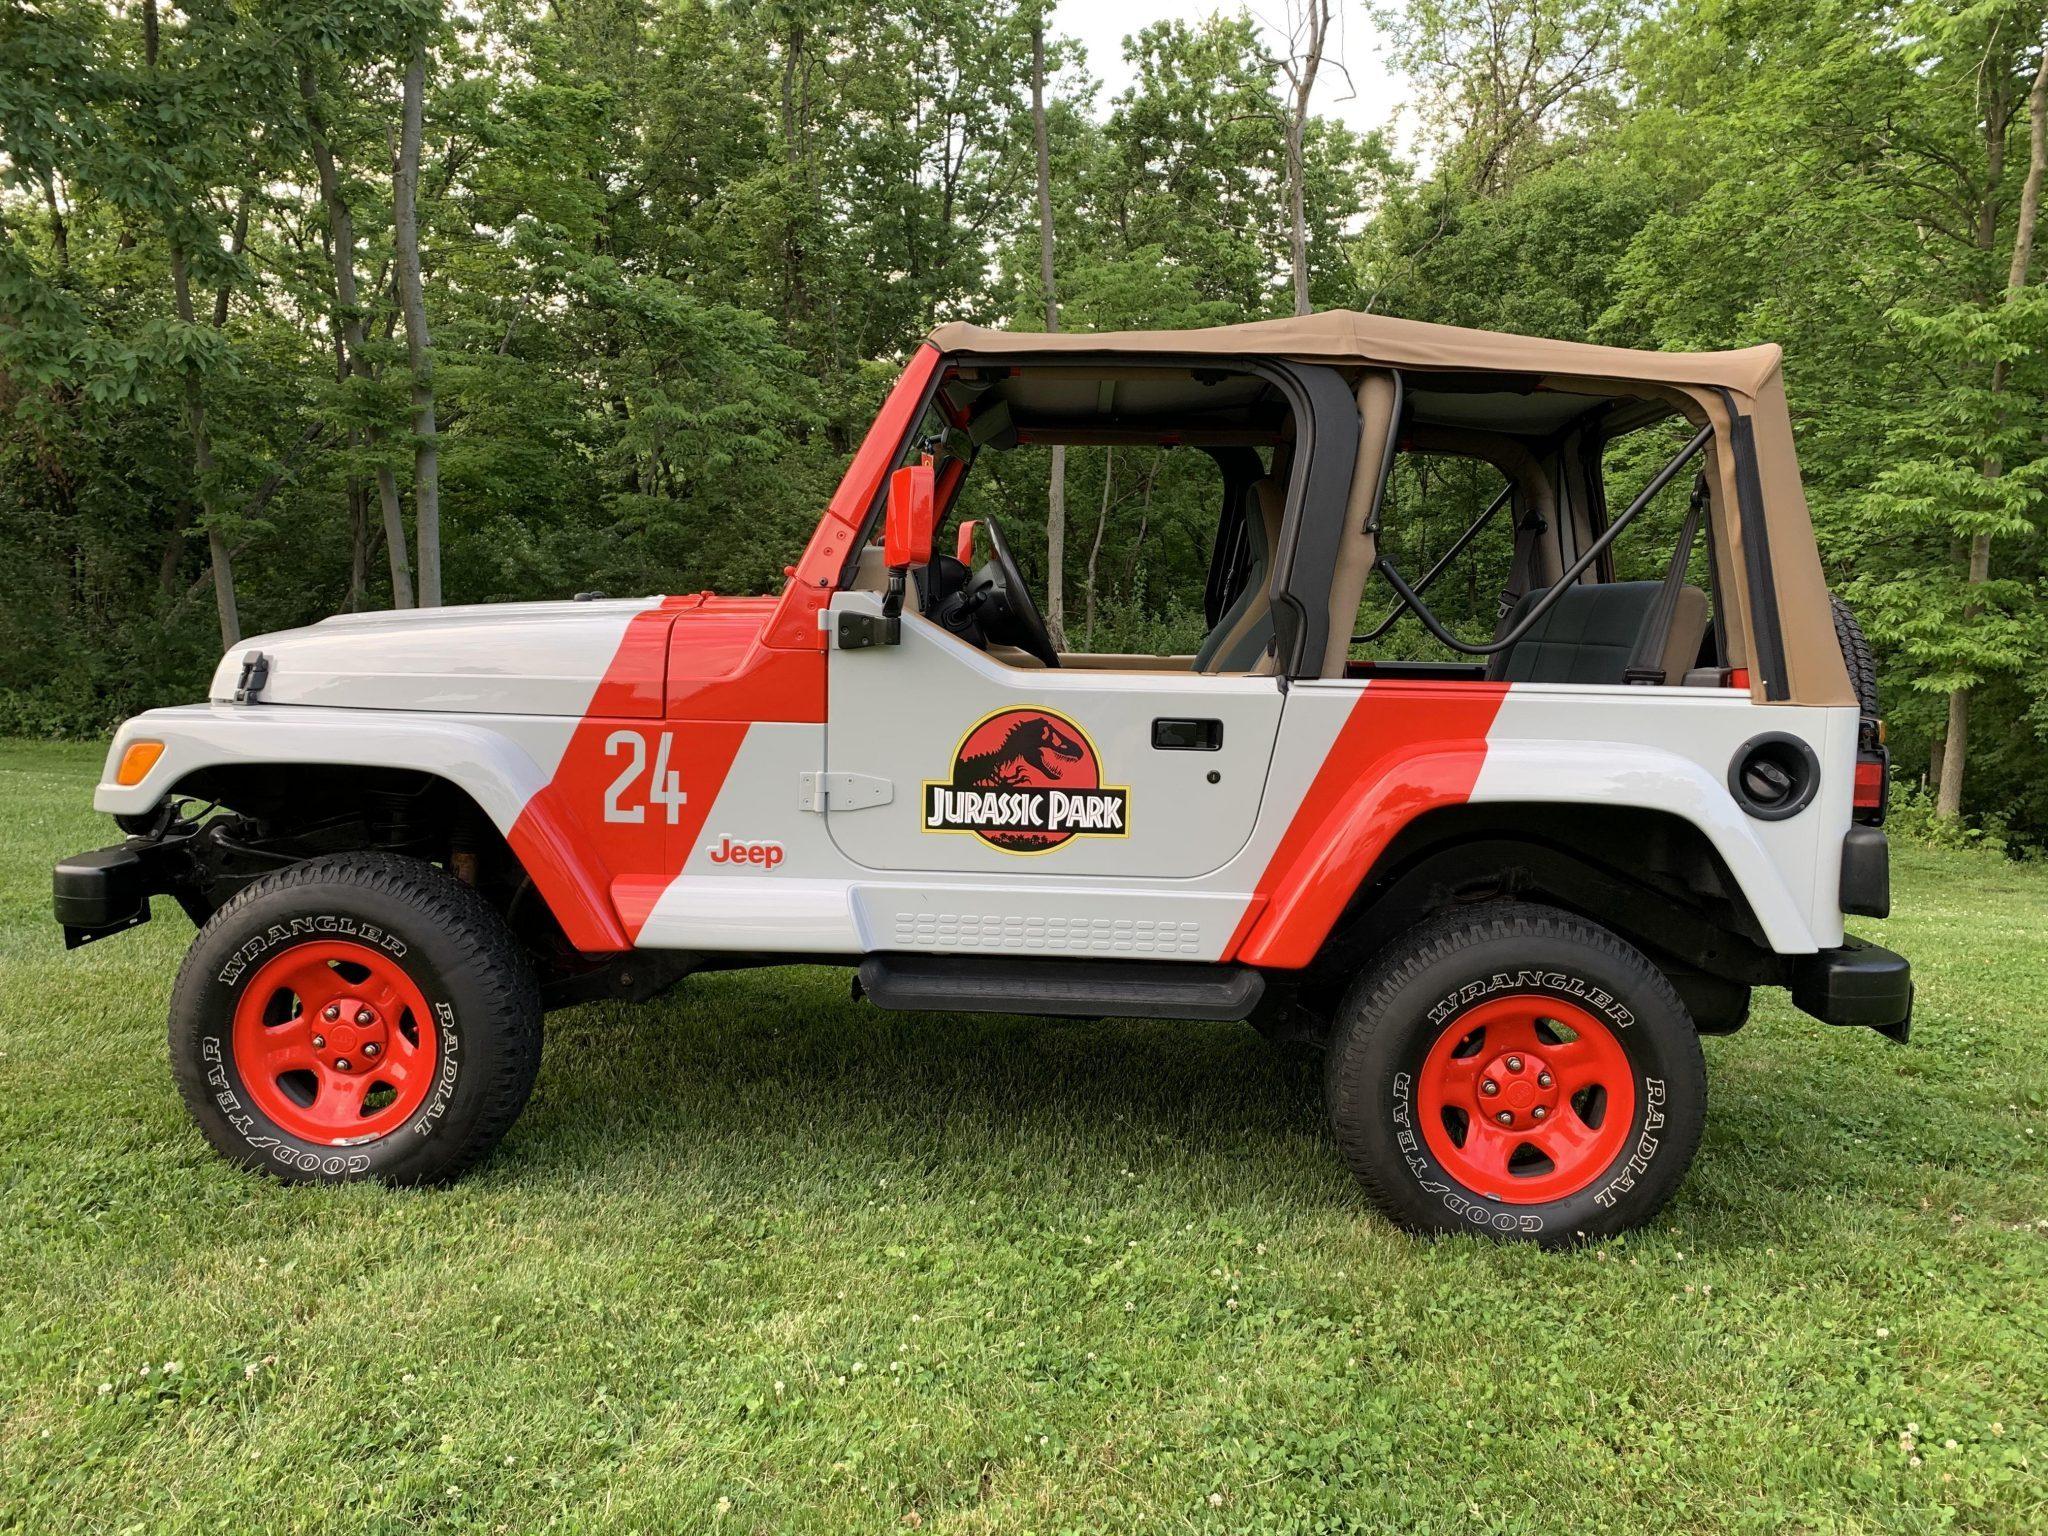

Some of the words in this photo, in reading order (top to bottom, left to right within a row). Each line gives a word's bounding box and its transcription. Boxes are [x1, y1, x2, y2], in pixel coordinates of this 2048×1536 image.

[604, 730, 688, 824] 24
[927, 787, 1044, 826] JURASSIC
[1048, 790, 1124, 830] PARK
[709, 838, 784, 869] Jeep
[218, 915, 408, 986] WRANGLER
[1427, 970, 1635, 1028] WRANGLER
[414, 1001, 459, 1137] RADIAL
[1593, 1077, 1666, 1209] RADIAL
